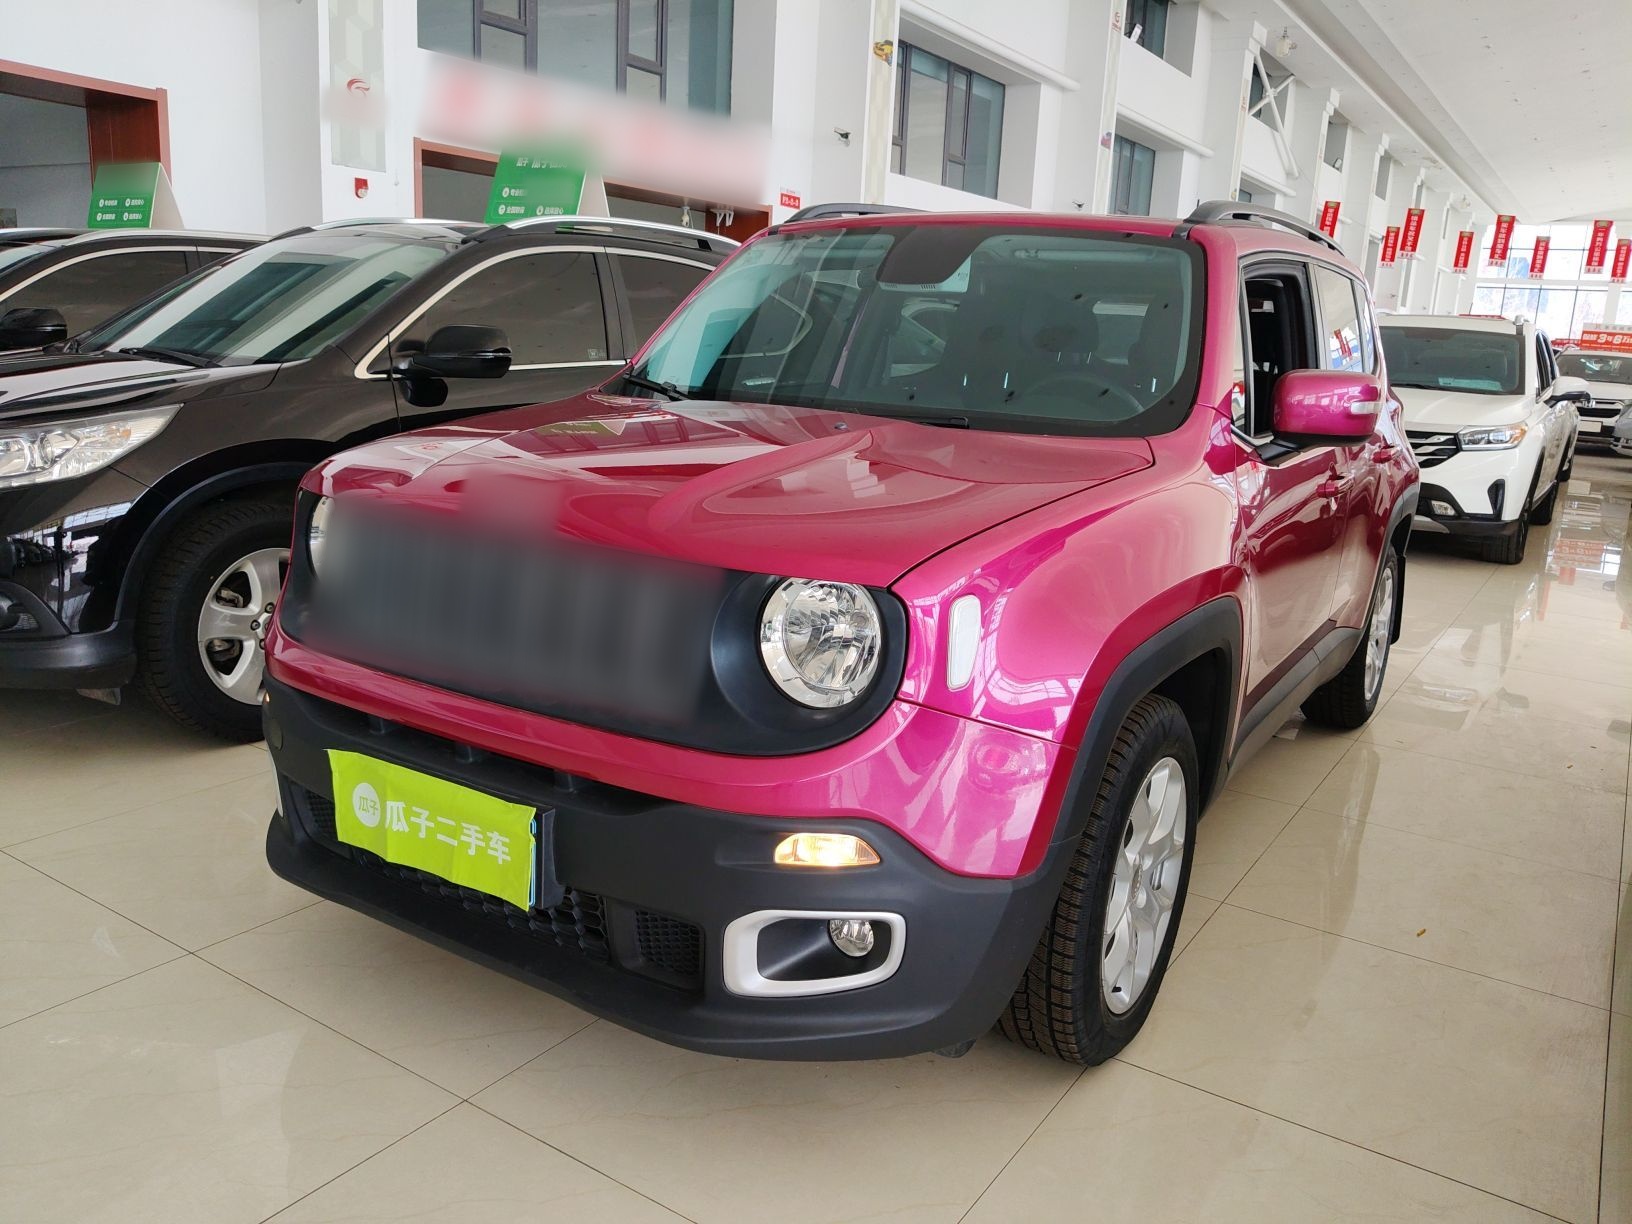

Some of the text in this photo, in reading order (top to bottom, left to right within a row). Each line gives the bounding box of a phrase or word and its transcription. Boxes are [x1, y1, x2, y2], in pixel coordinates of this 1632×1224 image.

[358, 795, 379, 816] 瓜子
[385, 800, 511, 865] 瓜子二手车
